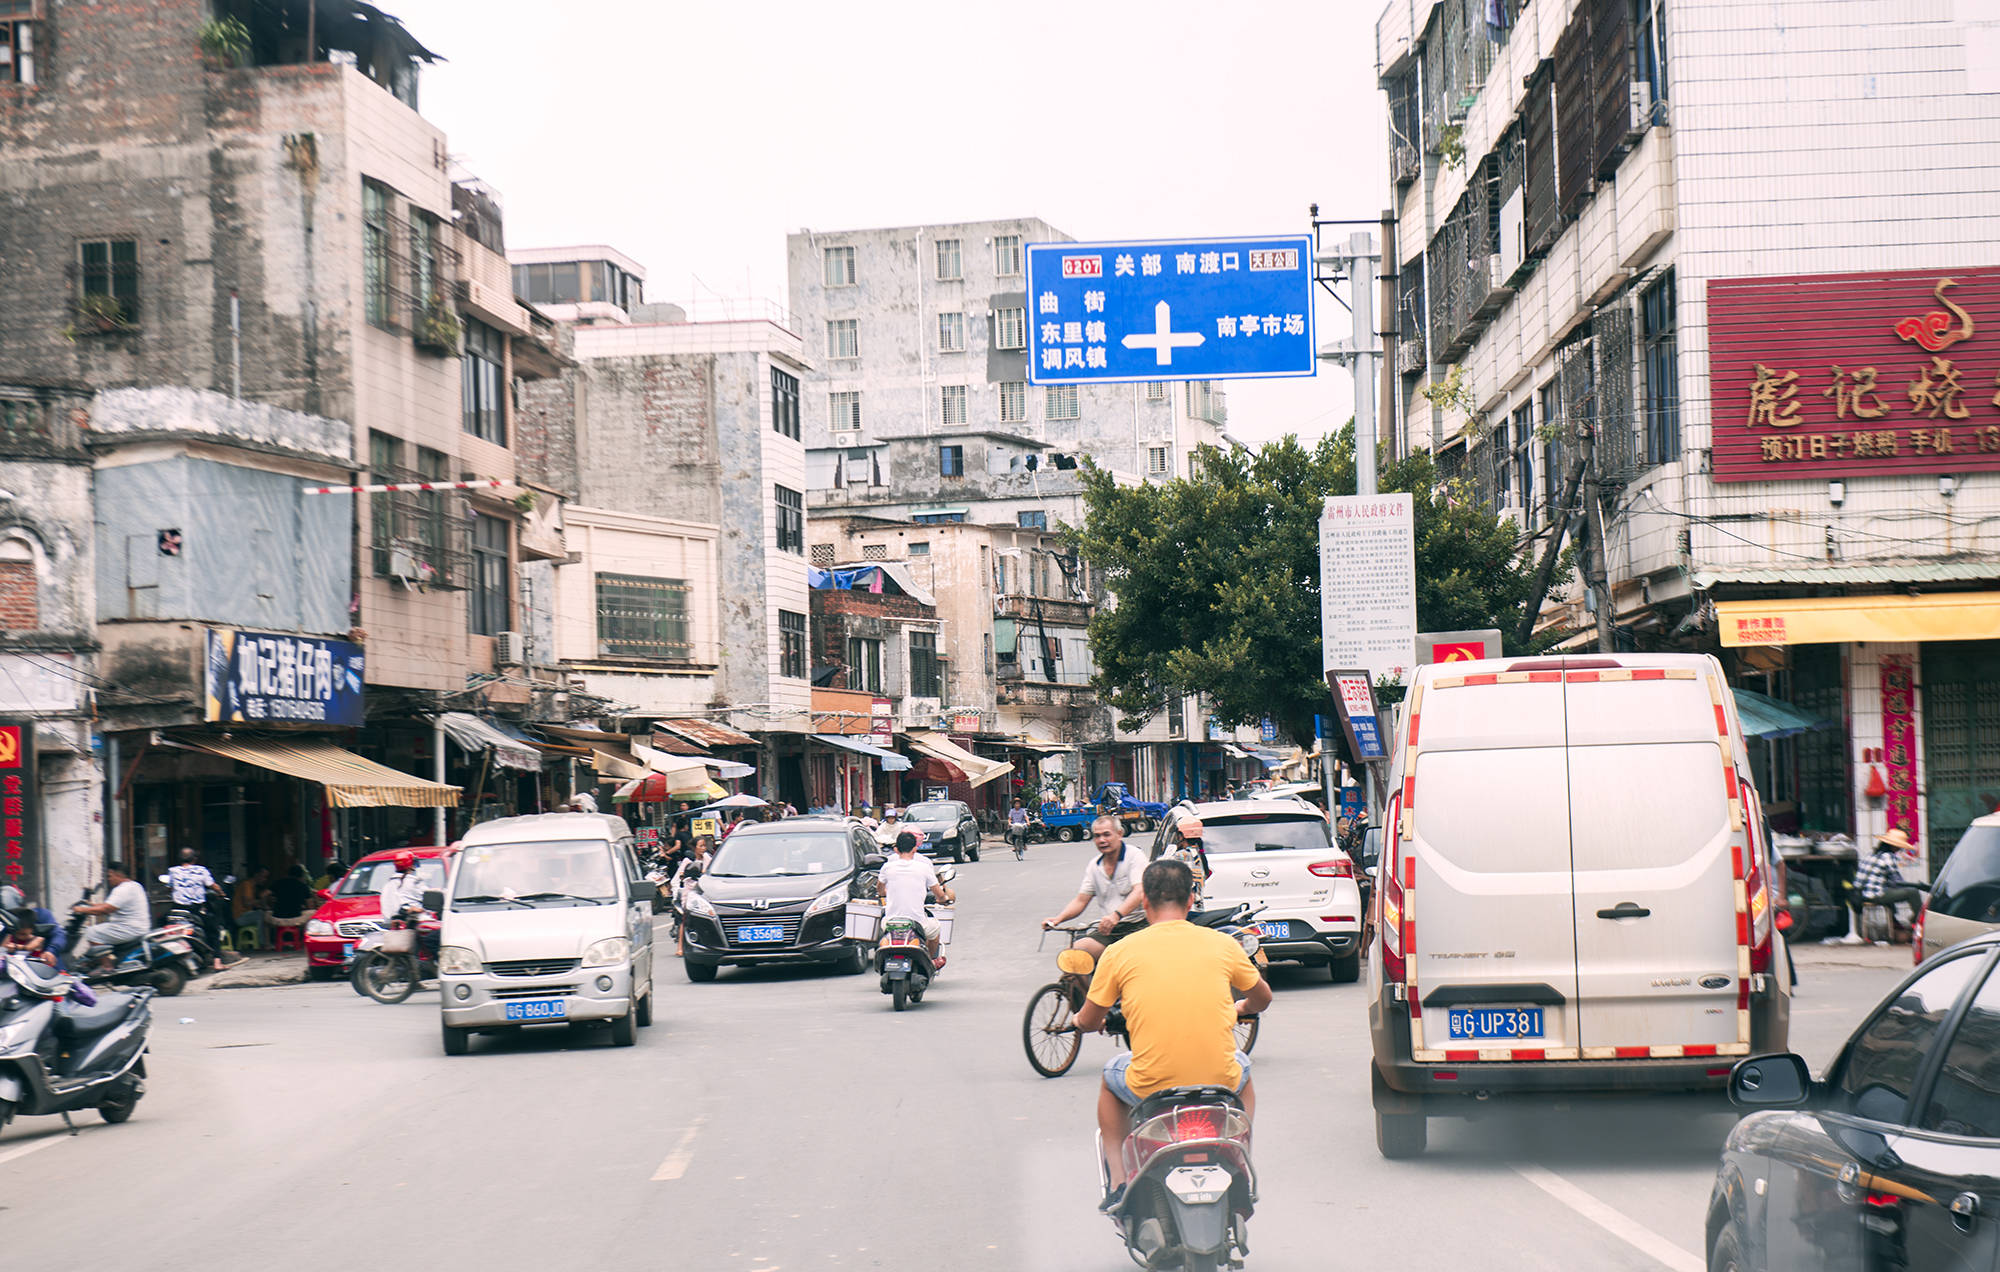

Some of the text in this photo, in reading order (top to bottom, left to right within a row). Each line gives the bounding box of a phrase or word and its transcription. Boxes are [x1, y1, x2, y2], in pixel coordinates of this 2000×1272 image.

[1064, 260, 1100, 275] G207
[1115, 252, 1240, 277] 关部 南渡口
[1251, 250, 1298, 269] 天后公园
[1041, 320, 1107, 344] 东里镇
[1216, 313, 1304, 338] 南亭市场
[1041, 346, 1107, 370] 调风镇
[1747, 356, 2000, 428] 彪记烧
[1327, 503, 1403, 520] 雷州市人民政府文件
[237, 634, 332, 701] 如记猪仔肉
